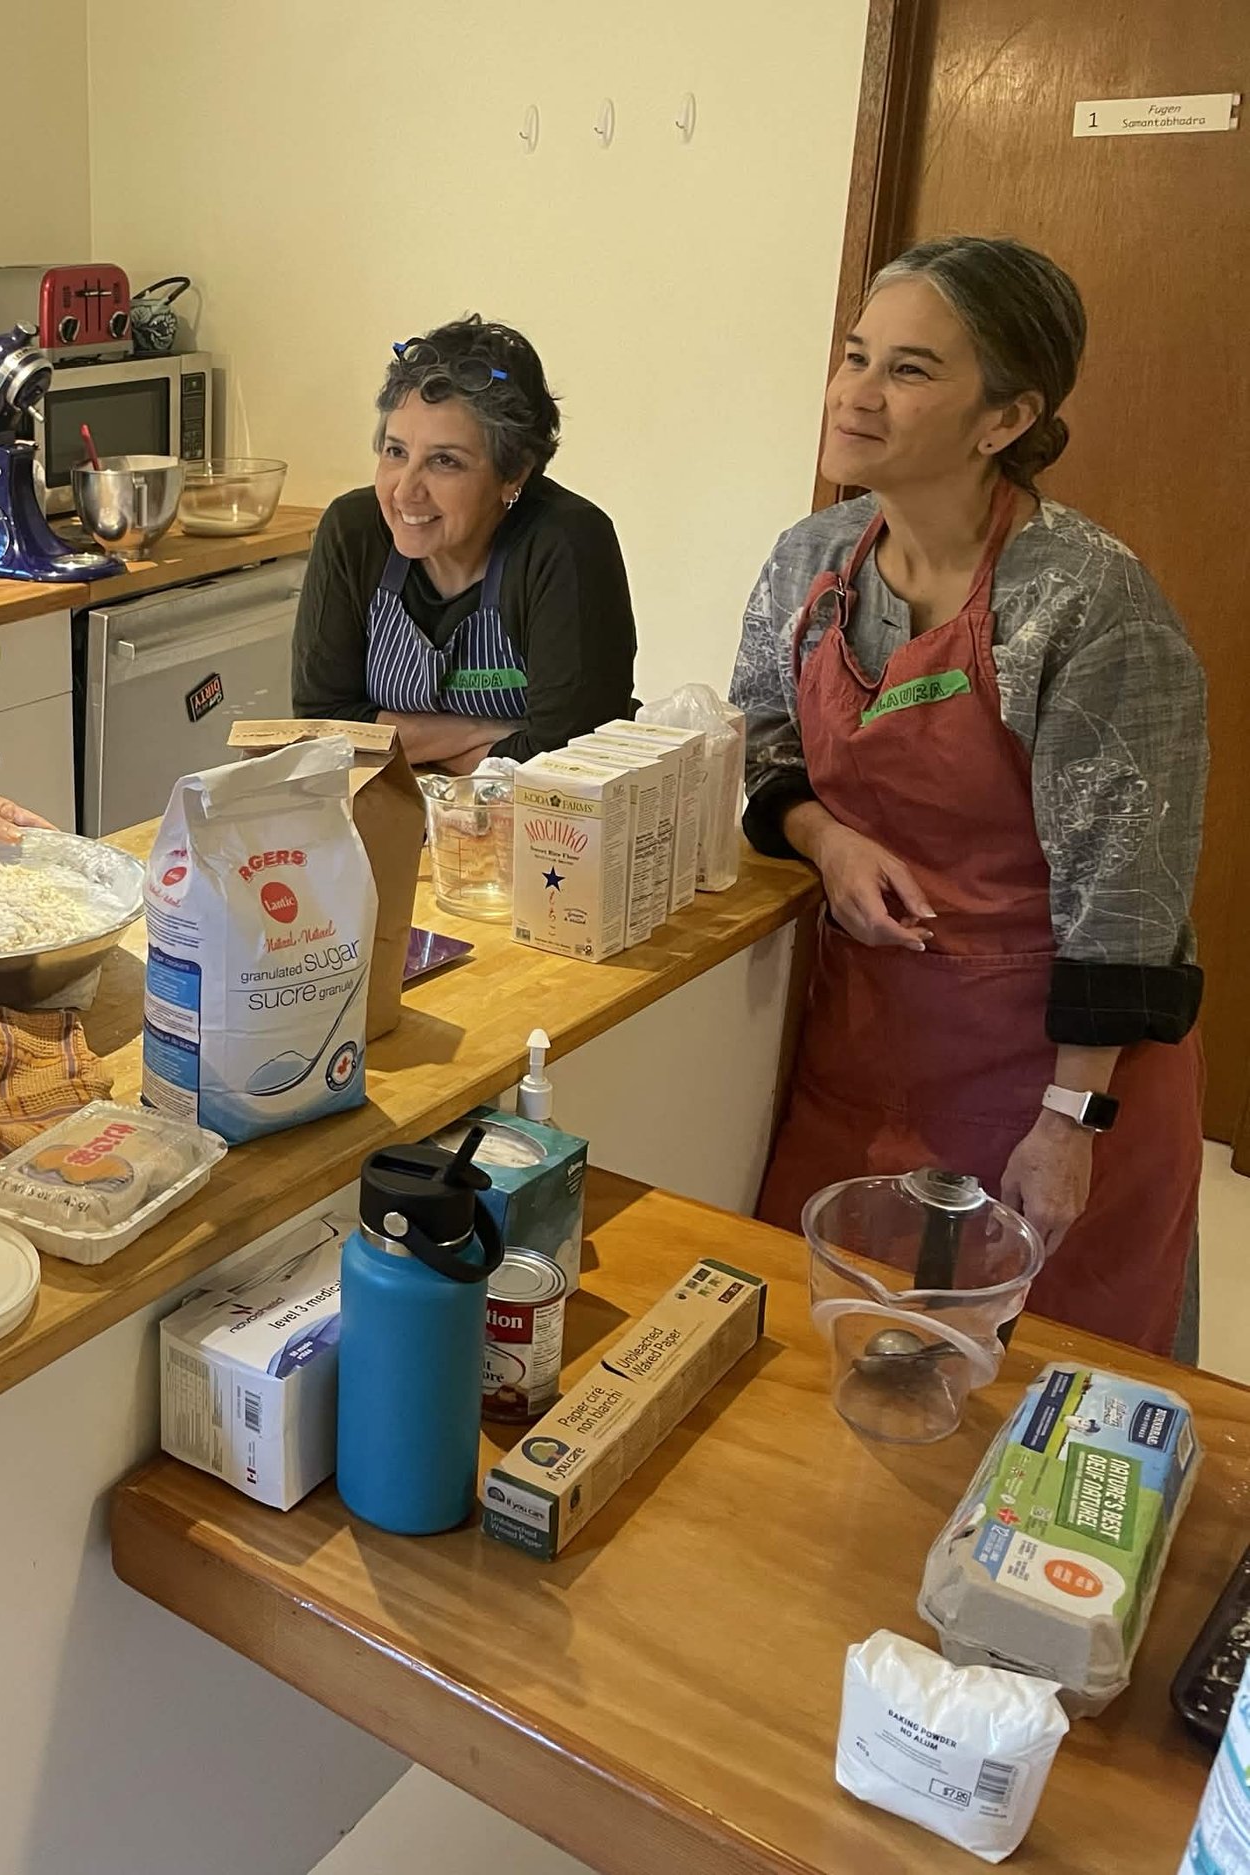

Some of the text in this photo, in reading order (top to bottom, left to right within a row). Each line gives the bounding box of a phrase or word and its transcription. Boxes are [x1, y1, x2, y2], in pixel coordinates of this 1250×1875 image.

[1088, 112, 1099, 128] 1
[1122, 117, 1206, 129] Samantabhadra
[1148, 104, 1182, 116] Fugen
[195, 679, 220, 709] DIRTY
[876, 682, 945, 712] LAURA
[524, 792, 594, 812] KODA FARMS
[524, 819, 588, 853] MOCHIKO
[263, 896, 296, 911] Lantic
[303, 940, 360, 971] sugar
[241, 962, 303, 984] granulated
[248, 984, 317, 1011] sucre
[268, 1310, 301, 1329] level
[294, 1305, 309, 1313] 3
[616, 1327, 664, 1369] Unbleached
[631, 1348, 662, 1377] Waxed
[658, 1328, 682, 1352] Paper
[557, 1401, 590, 1428] Papier
[586, 1383, 605, 1404] ciré
[577, 1419, 597, 1435] non
[592, 1388, 624, 1419] blanchi
[554, 1461, 571, 1480] you
[568, 1446, 586, 1463] care
[1083, 1453, 1108, 1484] OEUF
[1103, 1457, 1131, 1513] NATURE'S
[1076, 1480, 1104, 1529] NATUREL
[1100, 1508, 1124, 1545] BEST
[888, 1709, 958, 1749] BAKING POWDER
[900, 1726, 939, 1751] NO ALUM
